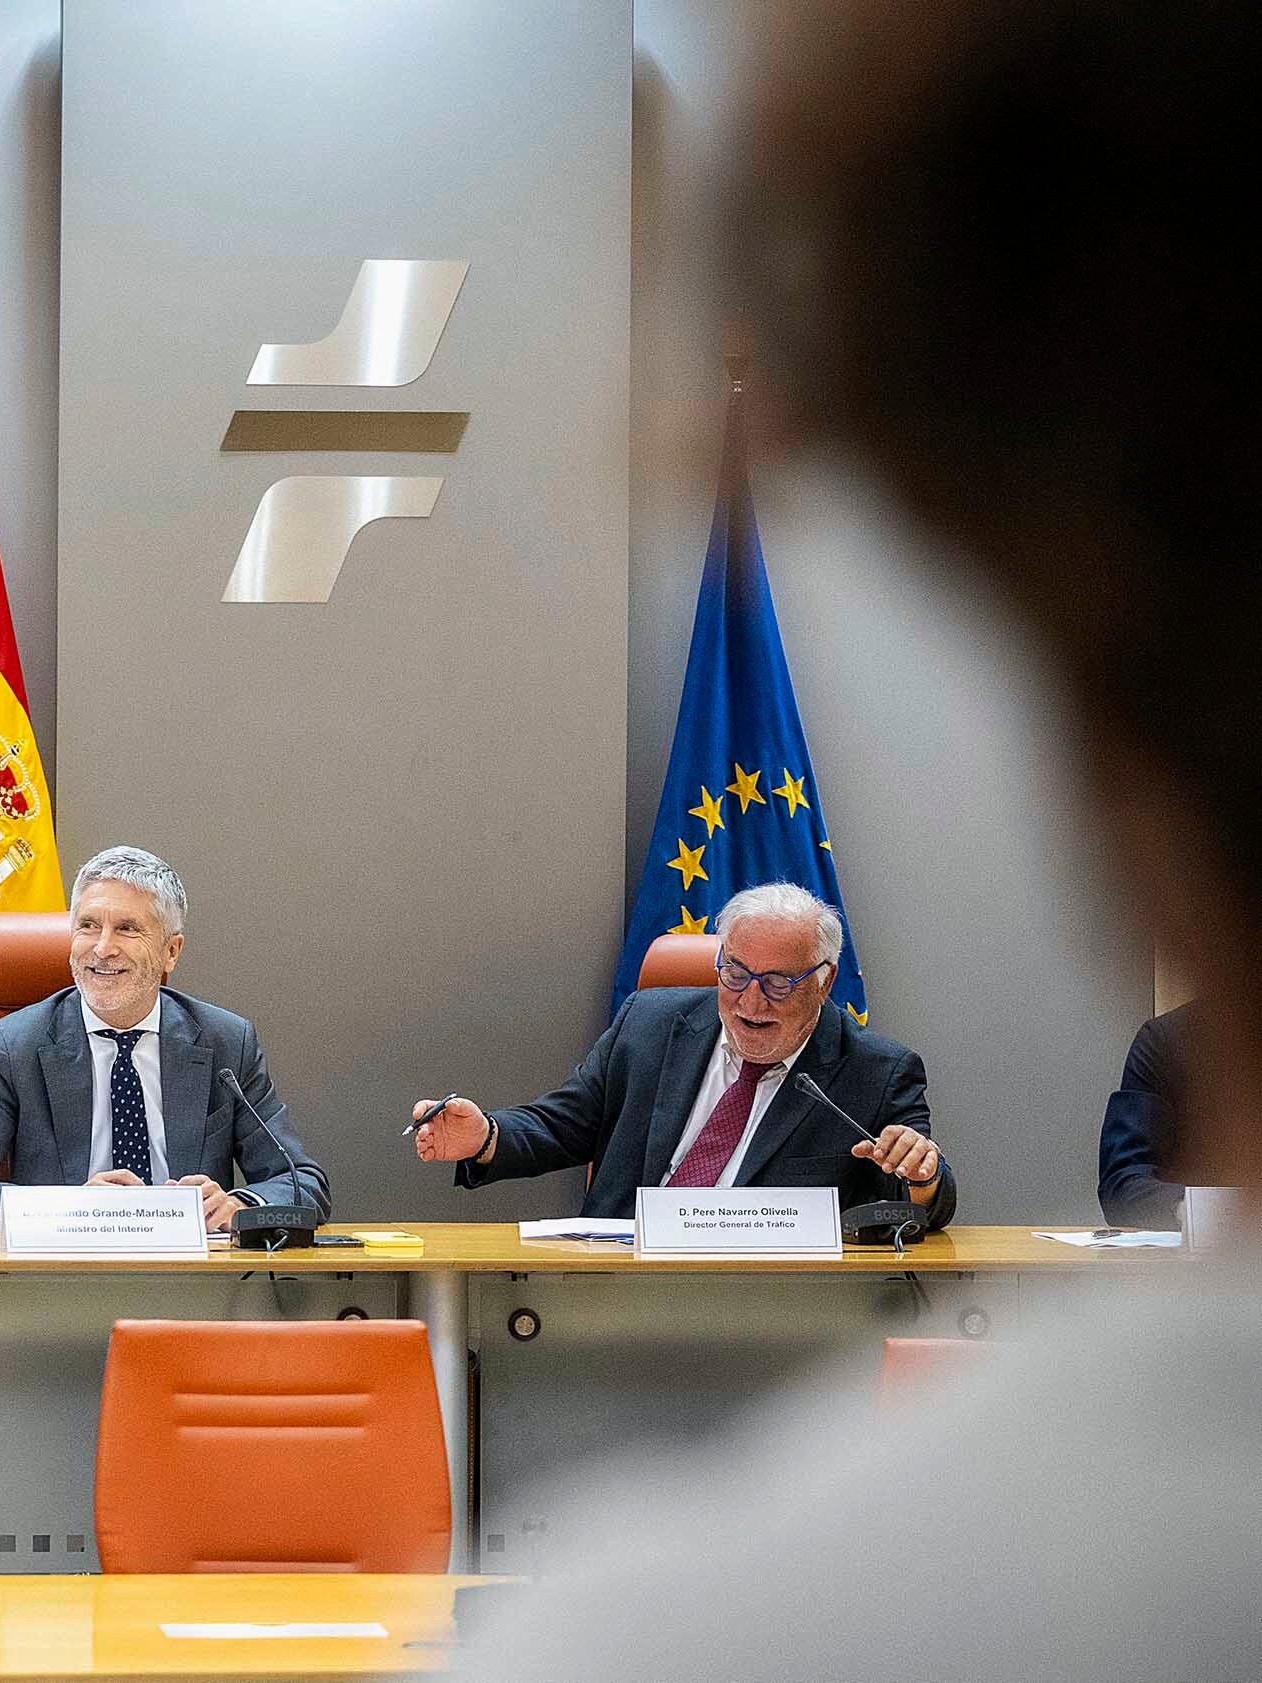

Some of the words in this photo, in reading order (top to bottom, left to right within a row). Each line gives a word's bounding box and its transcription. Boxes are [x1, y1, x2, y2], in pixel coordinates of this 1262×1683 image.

[92, 1208, 184, 1218] Grande-Marlaska
[679, 1208, 690, 1216] D.
[692, 1208, 715, 1216] Pere
[718, 1208, 758, 1216] Navarro
[760, 1207, 798, 1216] Olivella
[874, 1209, 915, 1220] BOSCH
[257, 1213, 302, 1225] BOSCH
[100, 1224, 115, 1233] del
[117, 1225, 154, 1233] Interior
[767, 1220, 796, 1228] Tráfico
